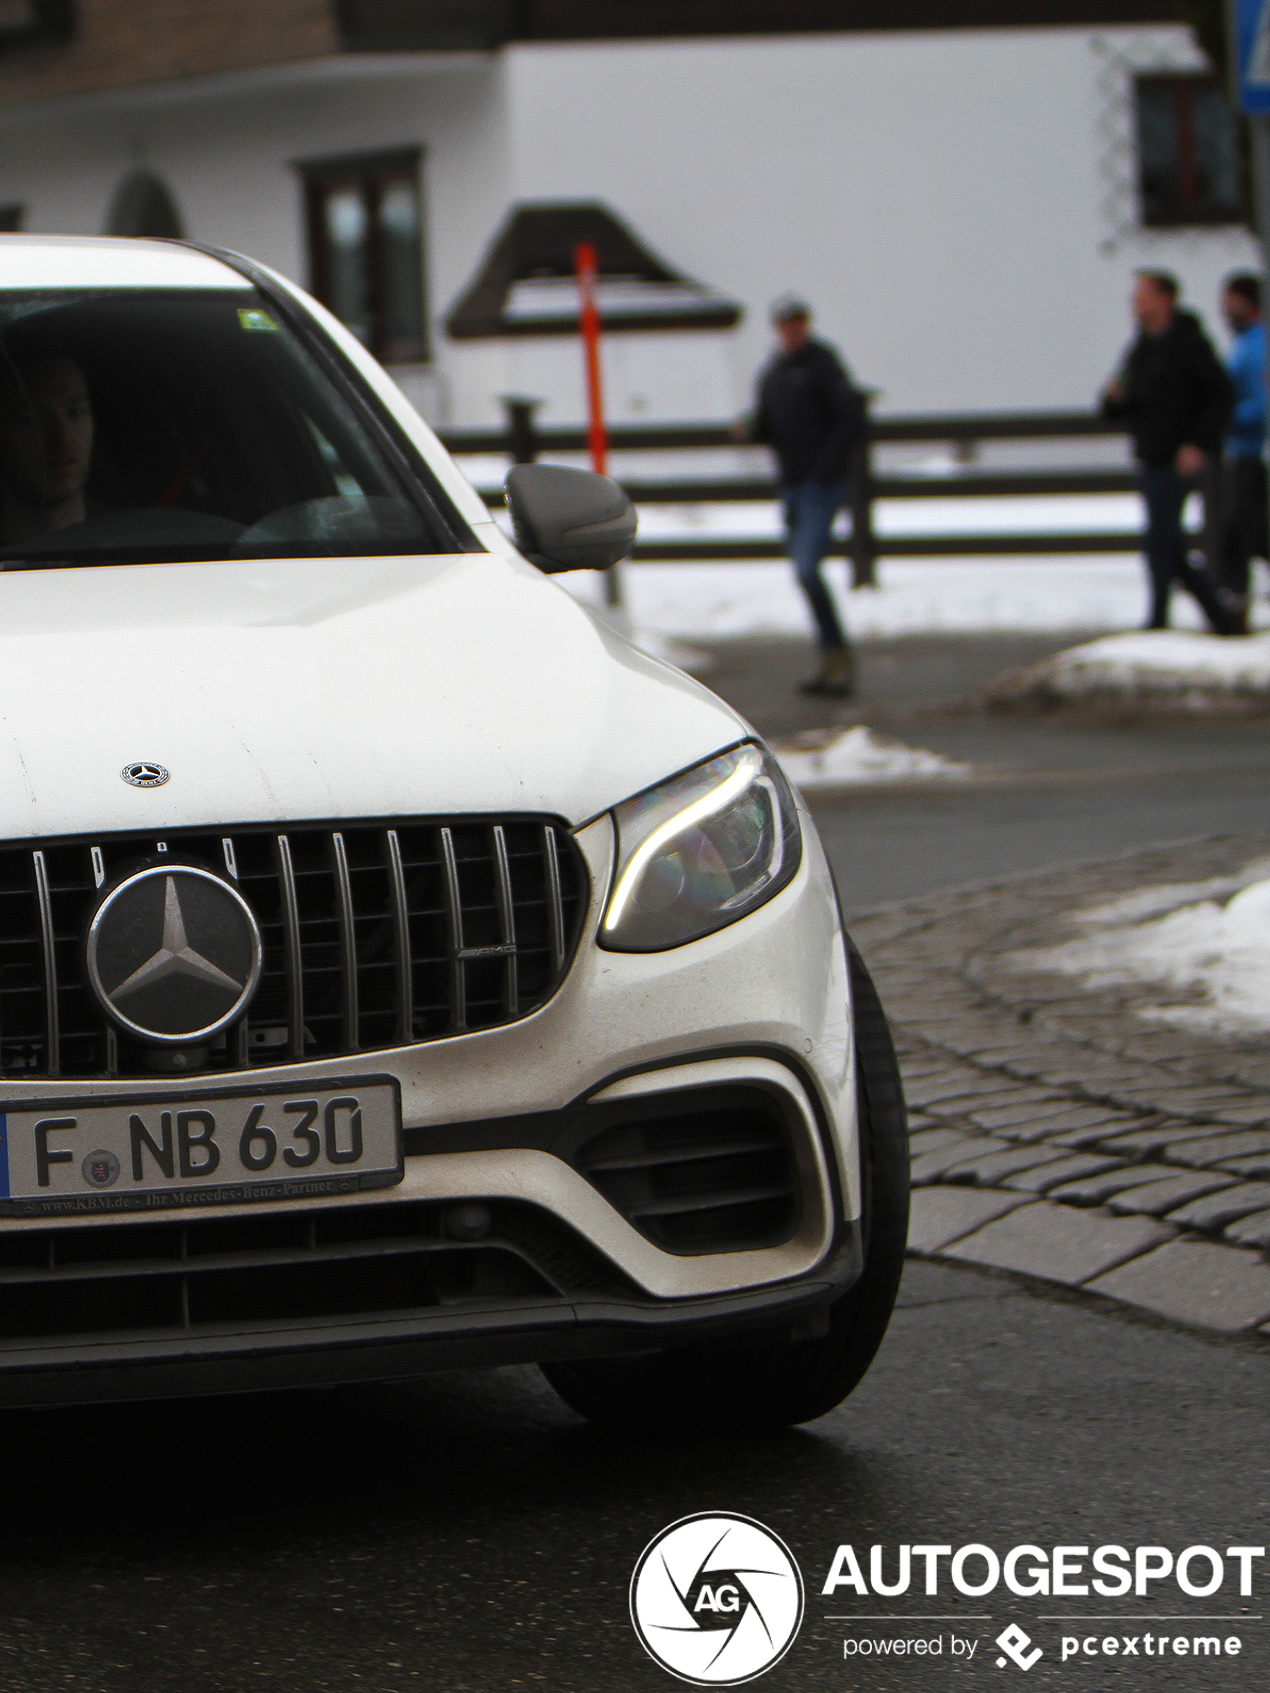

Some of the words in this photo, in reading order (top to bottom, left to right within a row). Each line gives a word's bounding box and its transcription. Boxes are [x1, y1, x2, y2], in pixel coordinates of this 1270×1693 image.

[34, 1117, 78, 1187] F
[129, 1109, 221, 1181] NB
[238, 1096, 365, 1171] 630
[144, 1193, 168, 1206] Ihr
